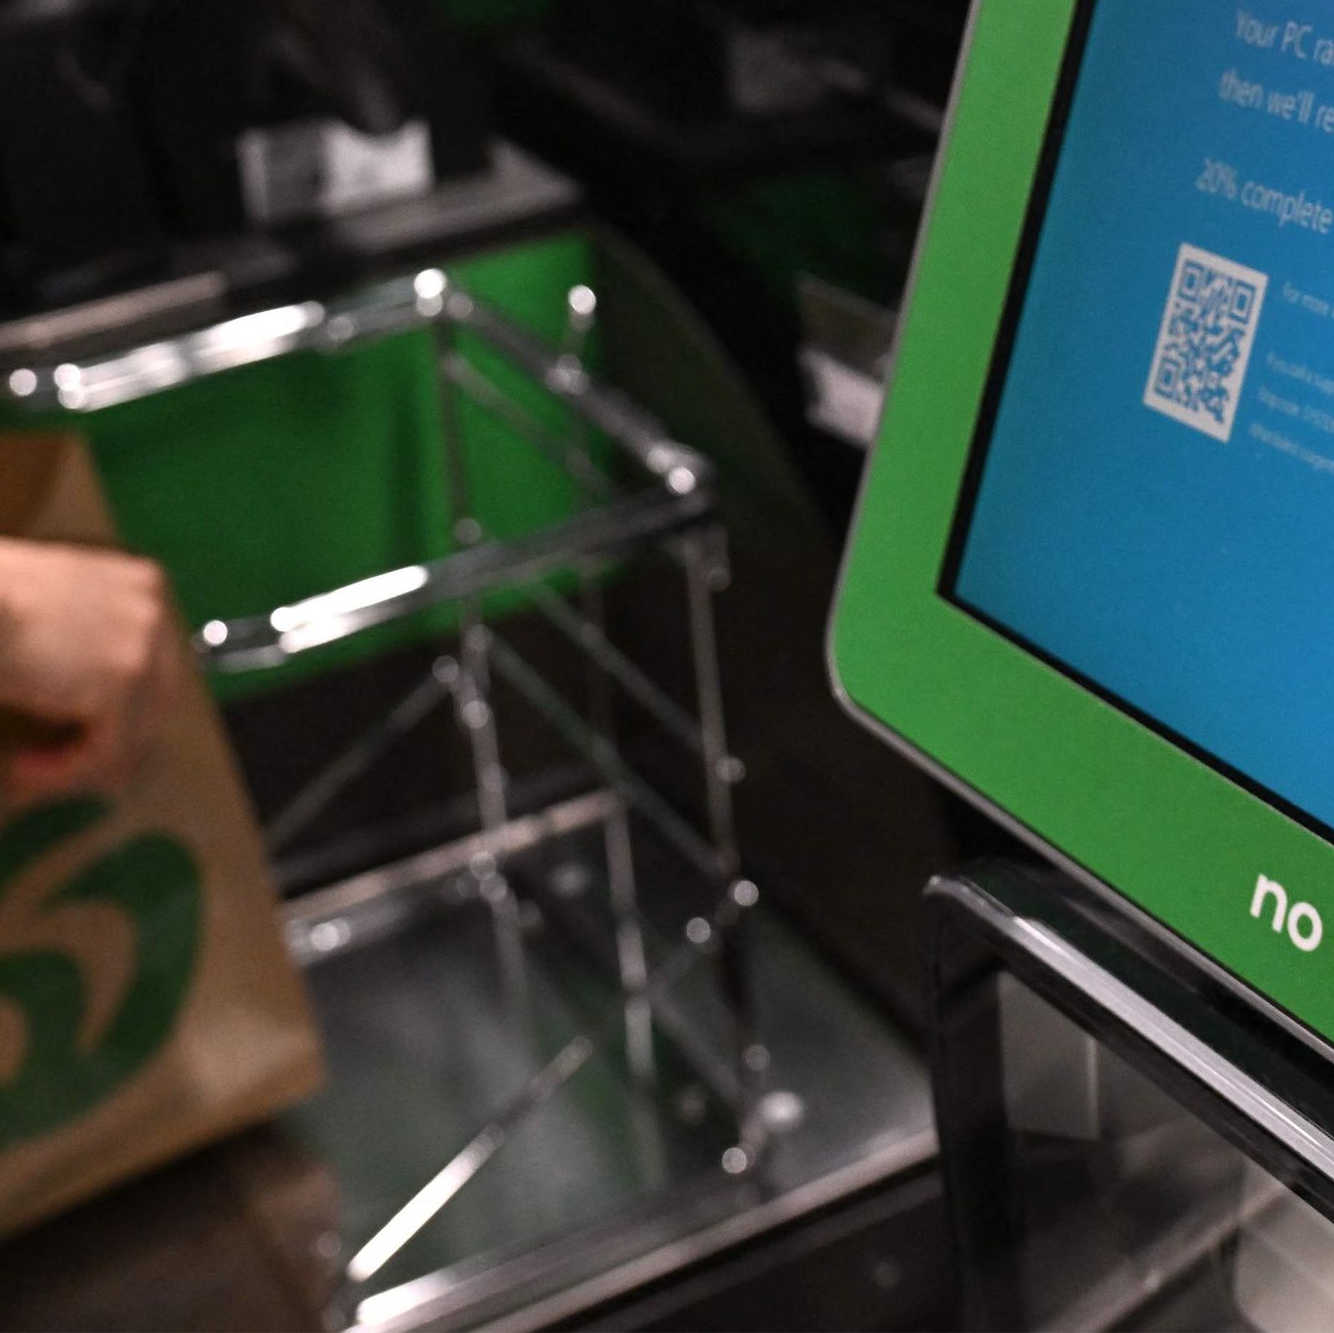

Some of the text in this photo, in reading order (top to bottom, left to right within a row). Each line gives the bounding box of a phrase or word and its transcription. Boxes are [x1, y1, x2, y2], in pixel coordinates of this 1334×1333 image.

[1234, 9, 1279, 49] Your
[1280, 20, 1314, 60] PC
[1217, 68, 1264, 110] then
[1266, 89, 1315, 124] we'll
[1196, 157, 1334, 235] 20% complete
[1249, 872, 1324, 953] no
